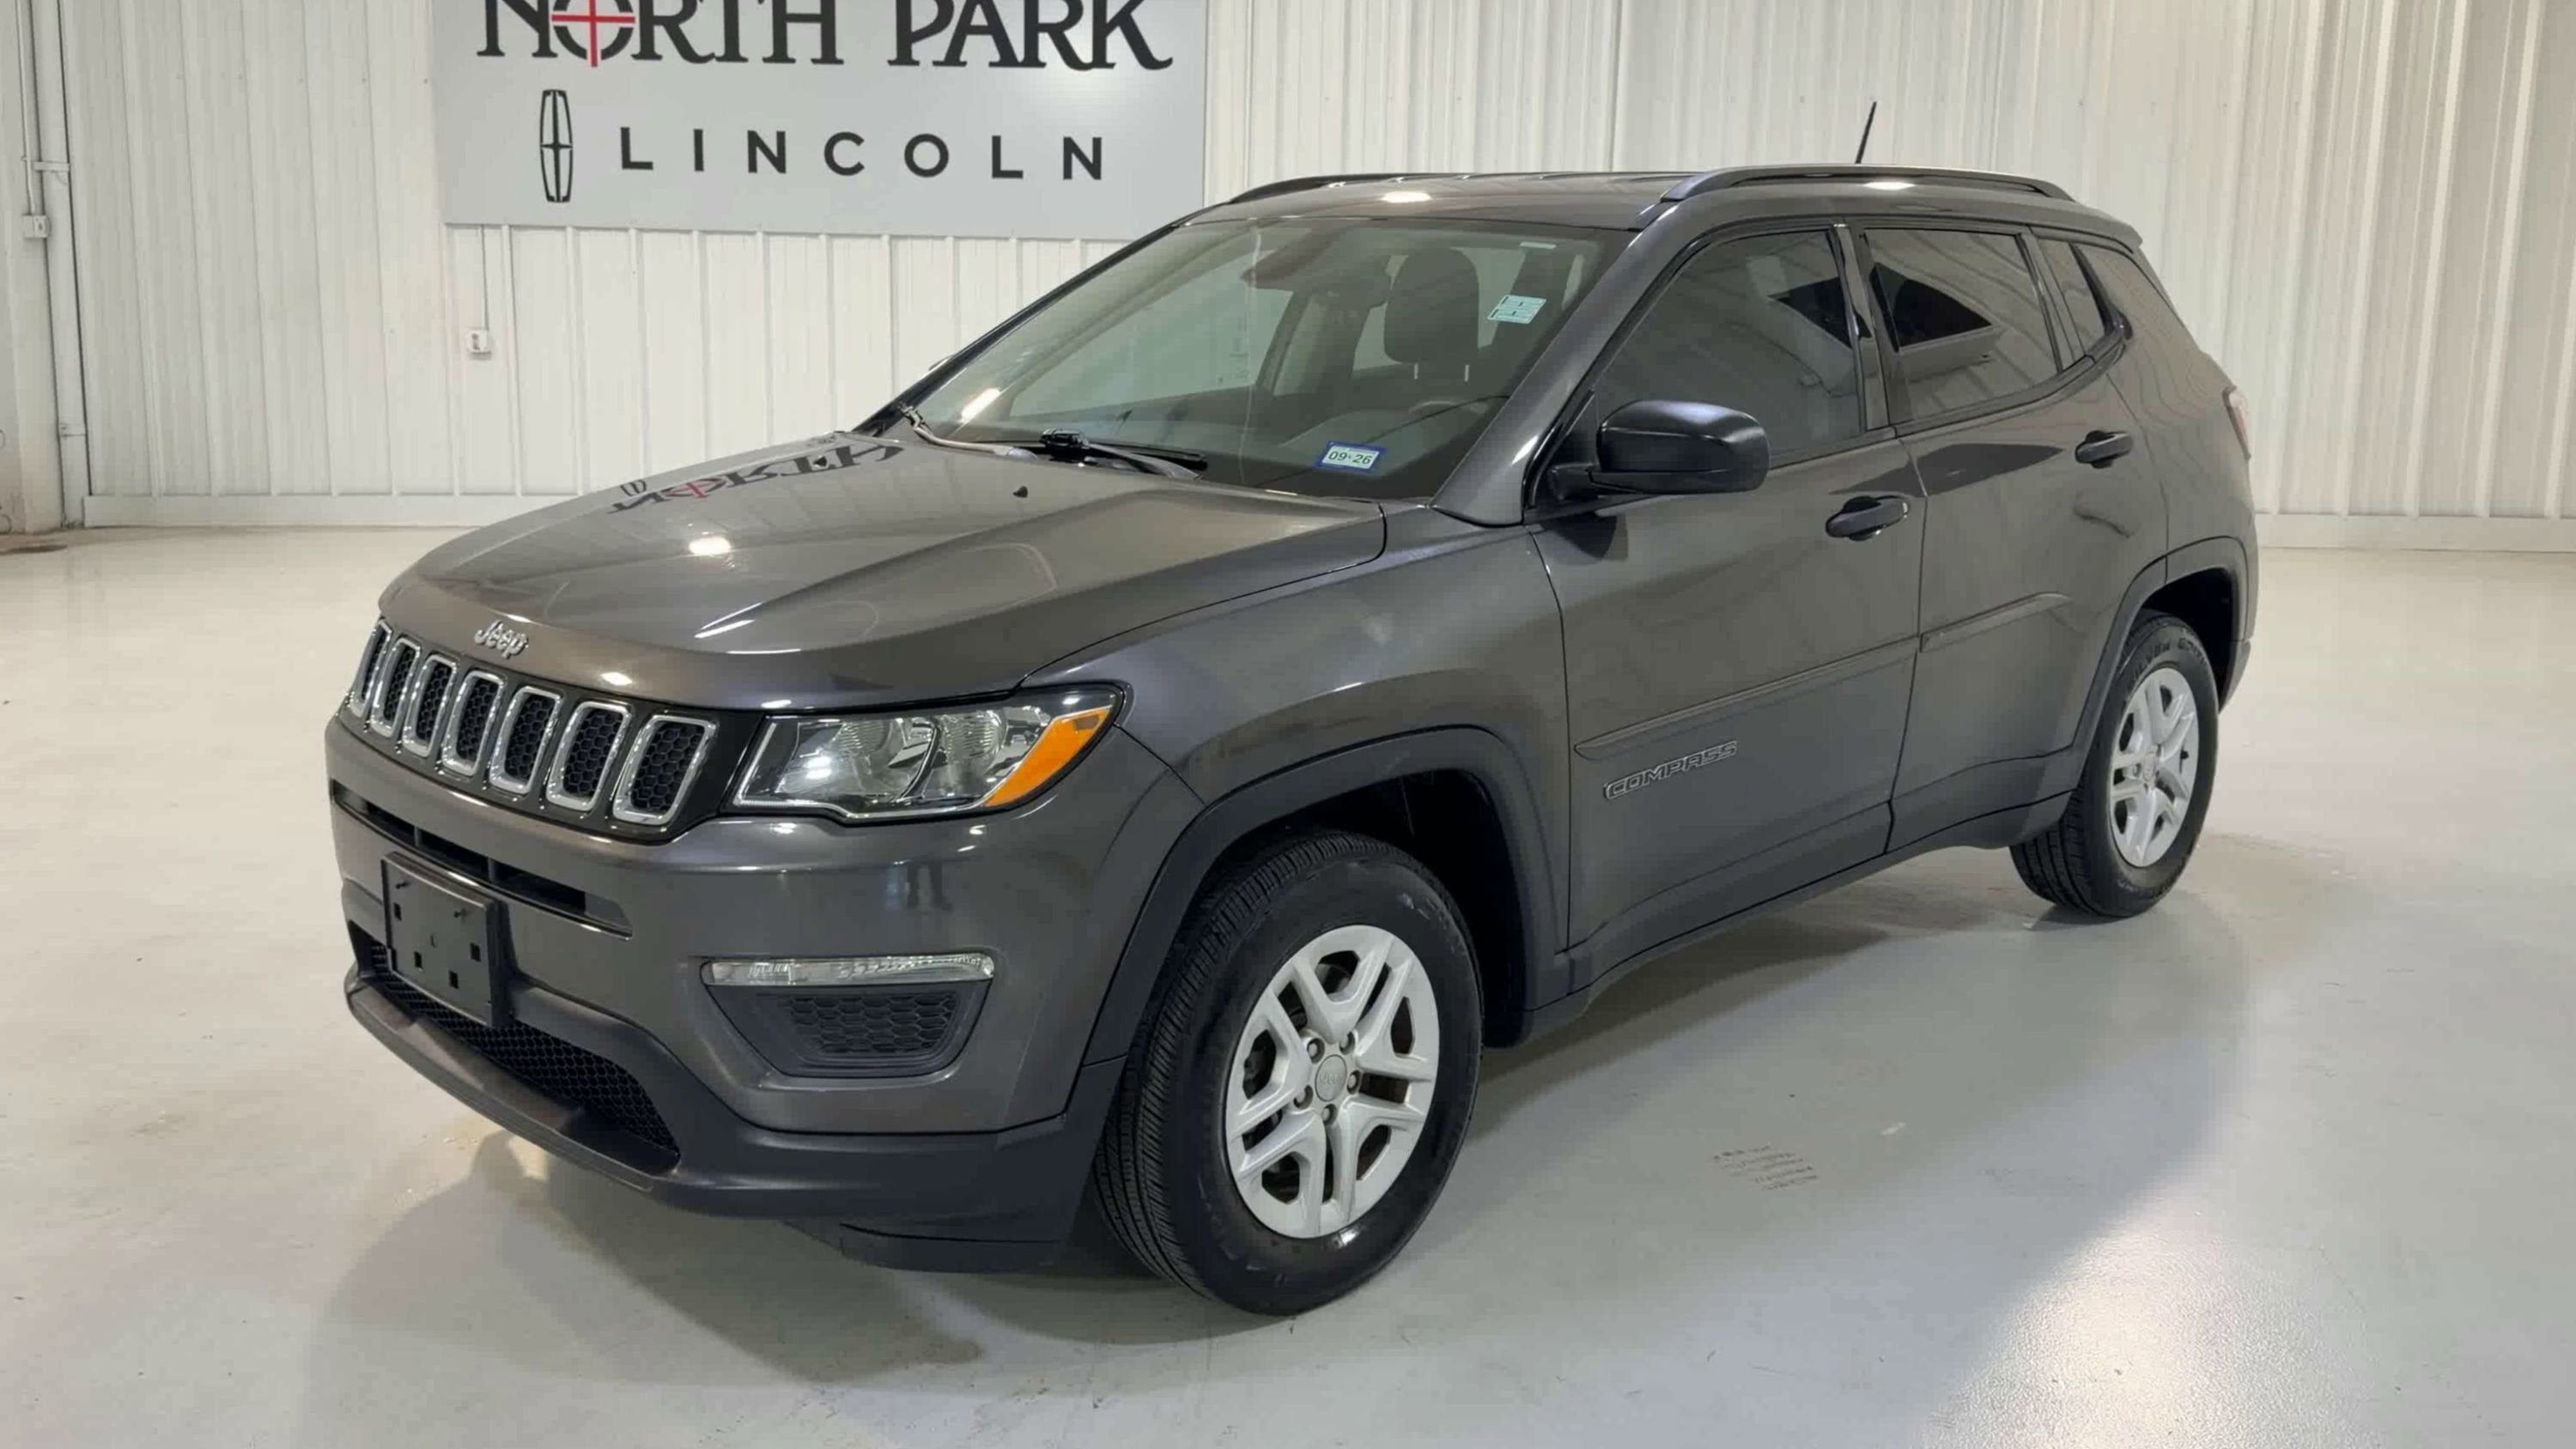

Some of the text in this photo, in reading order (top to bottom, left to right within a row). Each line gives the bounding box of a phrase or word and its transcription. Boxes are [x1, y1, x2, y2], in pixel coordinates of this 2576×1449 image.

[477, 0, 1173, 70] NORTH PARK
[620, 126, 1103, 180] LINCOLN
[474, 620, 529, 659] Jeep
[1603, 740, 1737, 800] COMPASS
